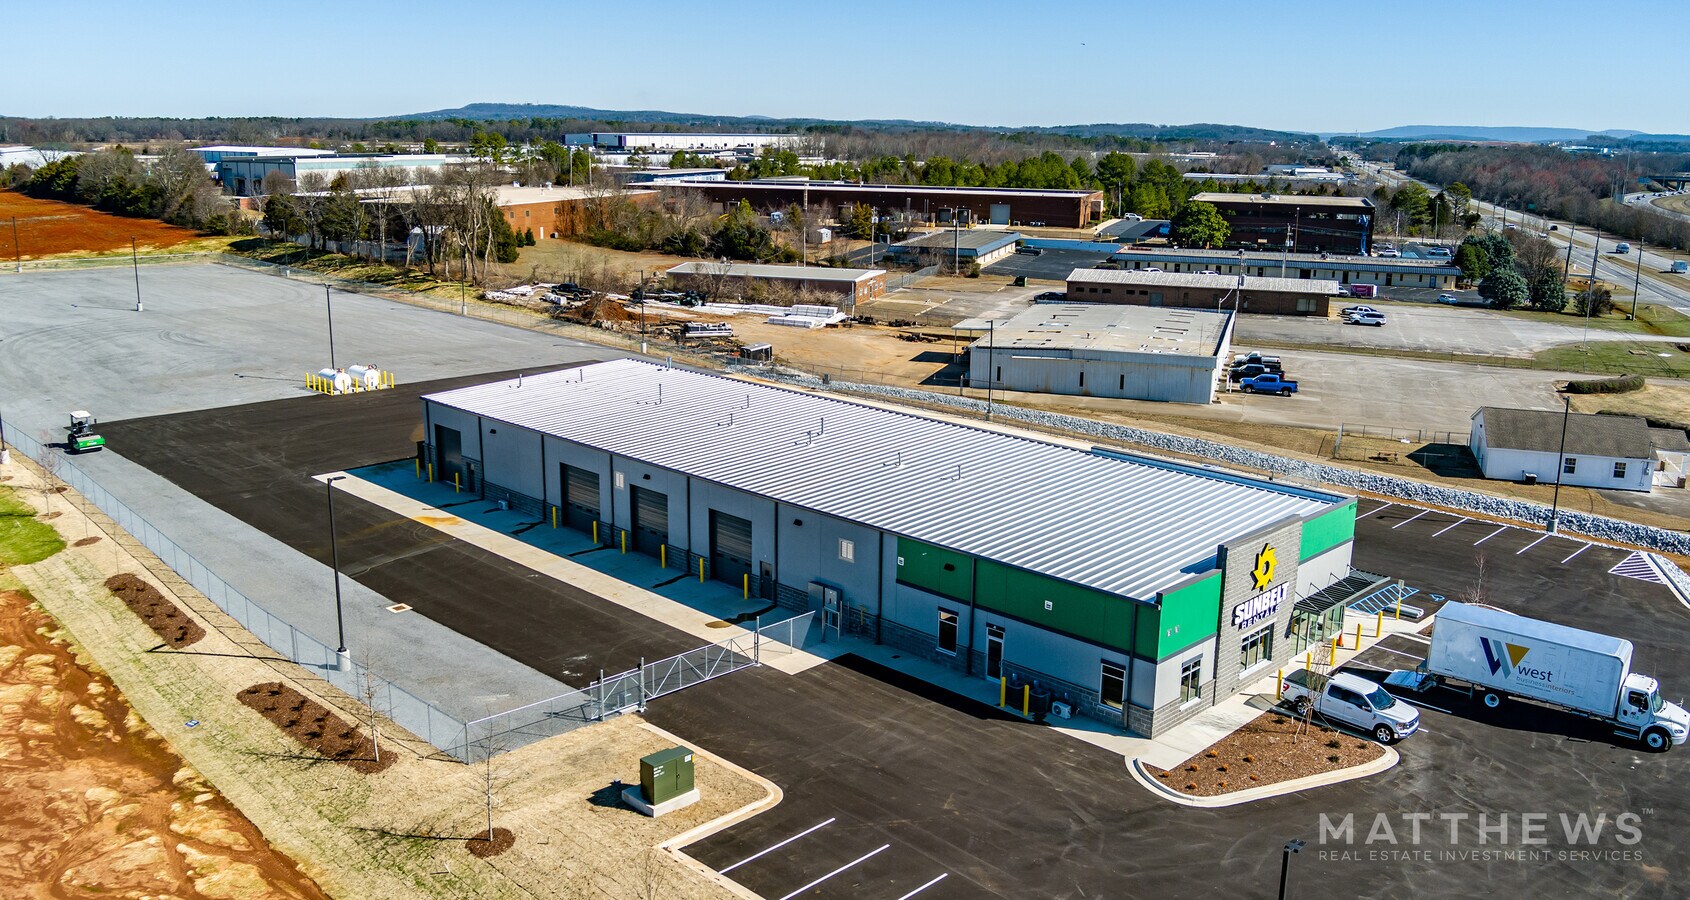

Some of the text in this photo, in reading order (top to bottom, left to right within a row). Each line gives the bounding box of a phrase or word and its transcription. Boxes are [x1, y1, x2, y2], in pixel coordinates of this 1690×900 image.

[1234, 581, 1290, 625] SUNBELT
[1239, 605, 1281, 630] RENTALS
[1518, 665, 1553, 682] west
